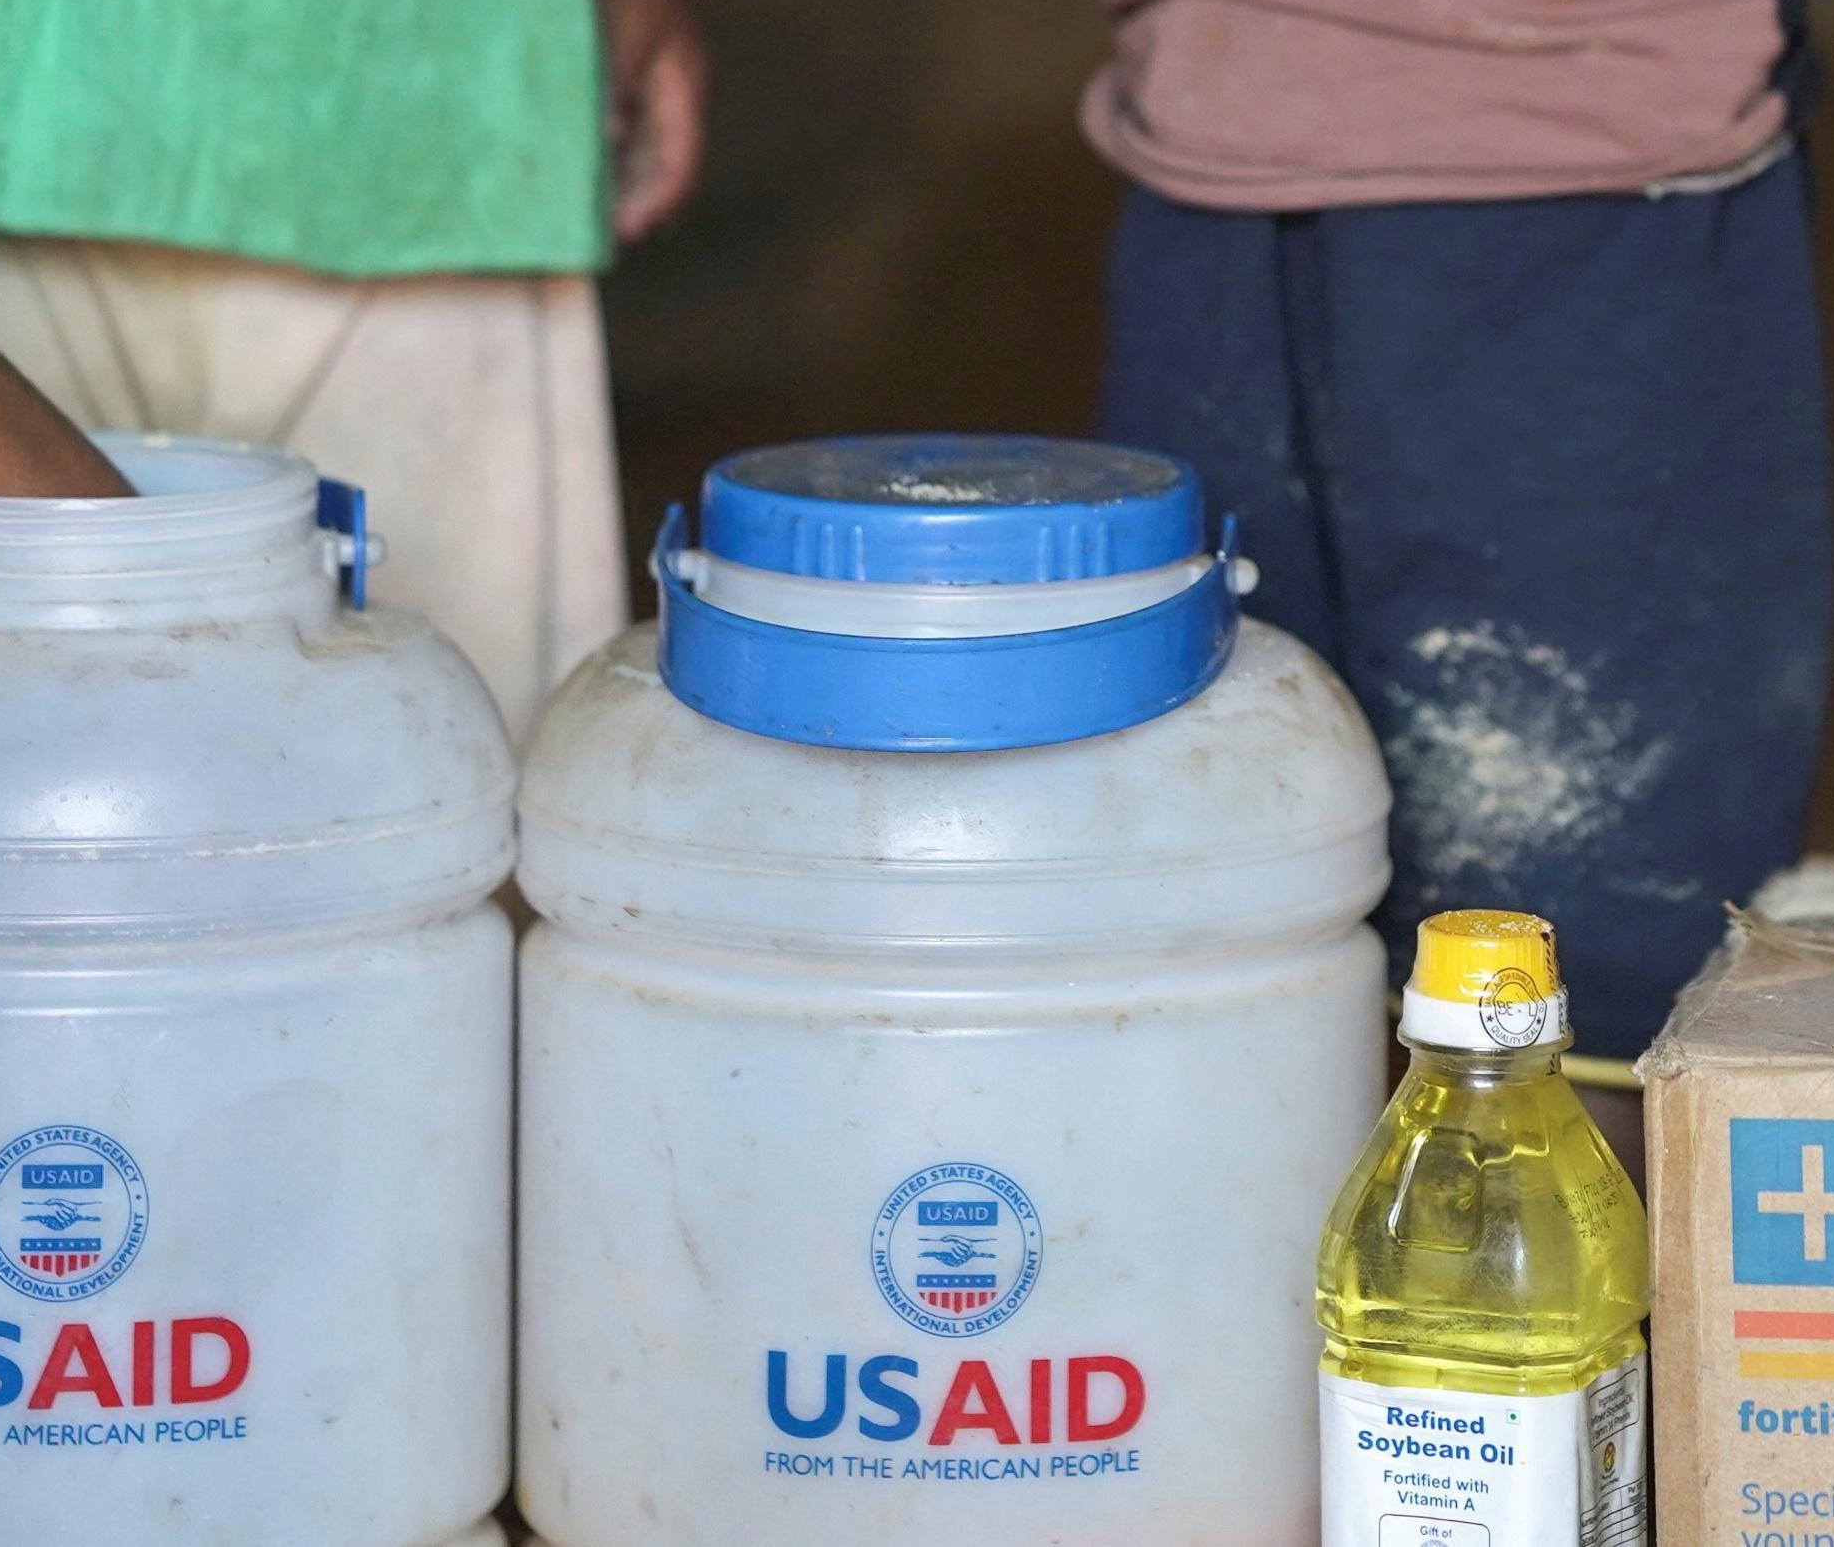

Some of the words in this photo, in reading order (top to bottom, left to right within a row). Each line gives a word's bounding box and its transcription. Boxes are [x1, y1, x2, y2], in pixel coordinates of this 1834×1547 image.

[1490, 1025, 1523, 1045] QUALITY
[1523, 1027, 1539, 1043] SEAL
[34, 1128, 90, 1145] STATES
[89, 1136, 141, 1184] AGENCY
[30, 1169, 95, 1185] USAID
[882, 1175, 928, 1222] UNITED
[930, 1166, 985, 1182] STATES
[985, 1174, 1035, 1221] AGENCY
[926, 1206, 989, 1221] USAID
[68, 1212, 144, 1298] DEVELOPMENT
[874, 1250, 961, 1334] INTERNATIONAL
[964, 1250, 1039, 1333] DEVELOPMENT
[767, 1350, 1146, 1446] USAID
[3, 1422, 145, 1446] AMERICAN
[155, 1416, 248, 1443] PEOPLE
[1387, 1406, 1485, 1435] Refined
[1357, 1430, 1470, 1460] Soybean
[1480, 1443, 1514, 1466] Oil
[765, 1451, 834, 1477] FROM
[842, 1456, 893, 1479] THE
[902, 1456, 1040, 1480] AMERICAN
[1051, 1450, 1140, 1477] PEOPLE
[1383, 1469, 1451, 1490] Fortified
[1456, 1478, 1489, 1494] with
[1397, 1490, 1459, 1510] Vitamin
[1463, 1498, 1476, 1512] A
[1419, 1525, 1439, 1537] Gift
[1441, 1528, 1453, 1539] of
